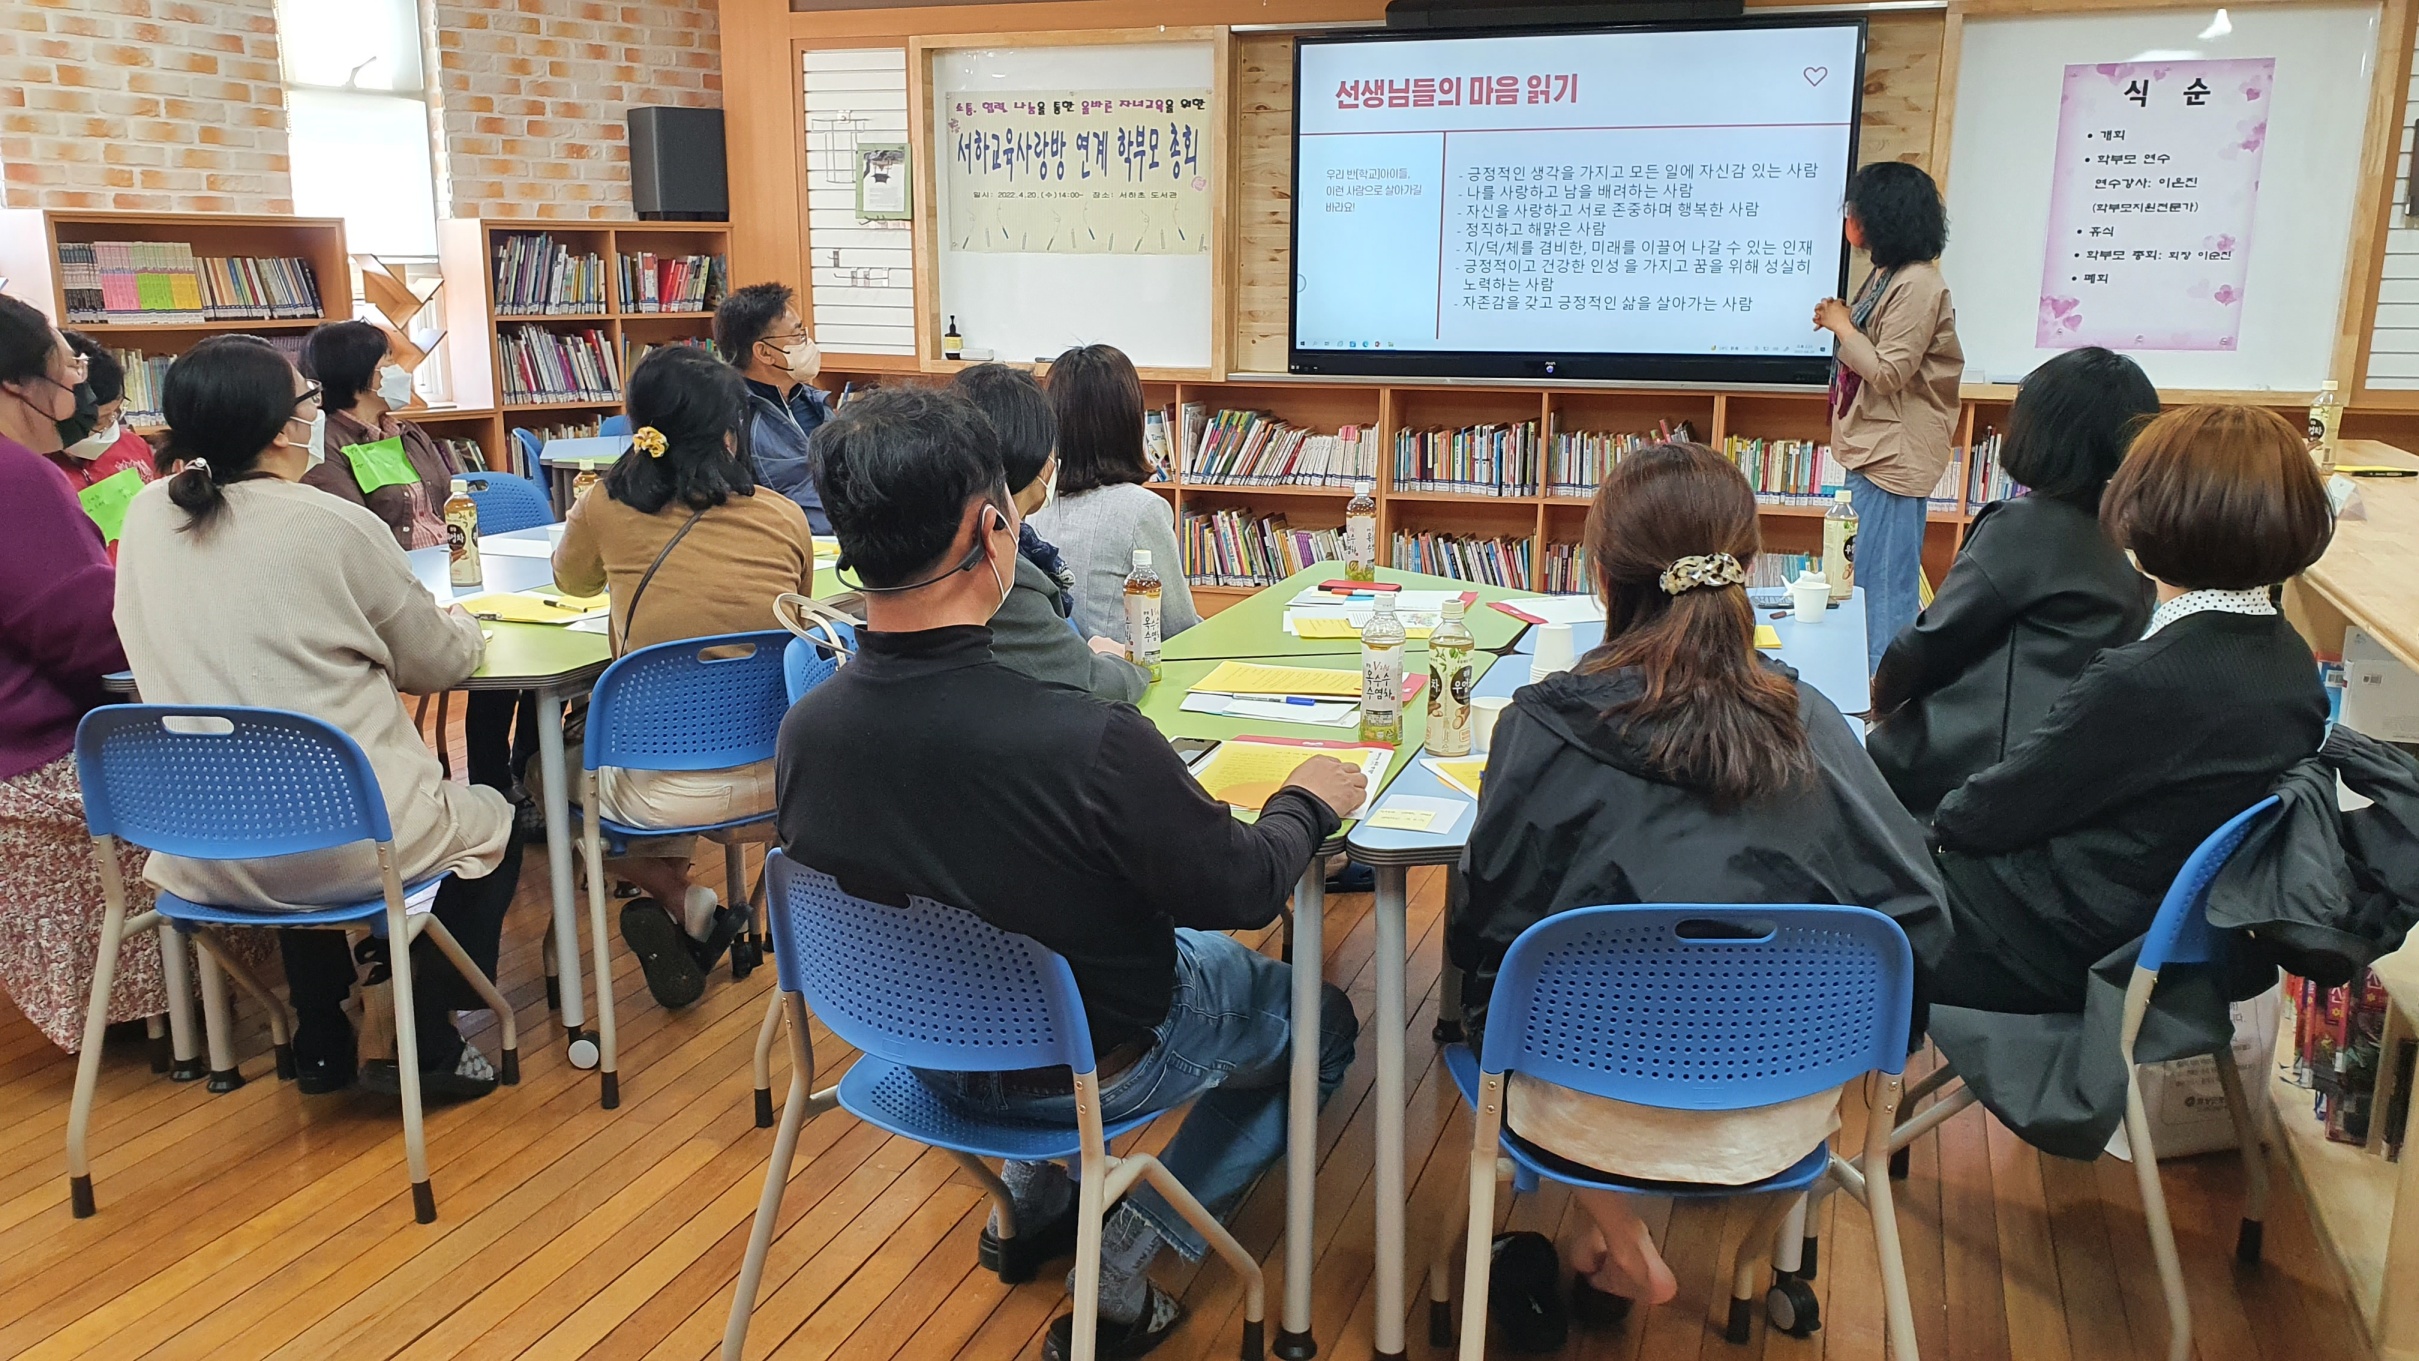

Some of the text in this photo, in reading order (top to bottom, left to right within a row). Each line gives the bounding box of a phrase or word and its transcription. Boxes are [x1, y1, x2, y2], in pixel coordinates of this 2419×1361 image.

[1335, 73, 1578, 109] 선생님들의 마음 읽기
[2123, 77, 2211, 107] 식 순
[1014, 101, 1046, 115] 나눔을
[1054, 100, 1076, 115] 통한
[1081, 100, 1113, 115] 올바른
[1119, 99, 1174, 113] 자녀교육을
[1180, 98, 1206, 110] 위한
[2100, 129, 2126, 141] 개회
[957, 122, 1199, 182] 서하교육사랑방 연계 학부모 총회
[2097, 153, 2171, 165] 학부모 연수
[1326, 169, 1345, 180] 우리
[1467, 162, 1819, 182] 긍정적인 생각을 가지고 모든 일에 자신감 있는 사람
[1326, 184, 1422, 196] 이런 사람으로 살아가길
[1466, 182, 1694, 201] 나를 사랑하고 남을 배려하는 사람
[2095, 178, 2152, 189] 연수강사:
[1151, 191, 1178, 199] 도서관
[1466, 201, 1760, 219] 자신을 사랑하고 서로 존중하며 행복한 사람
[2092, 202, 2199, 213] (학부모지원전문가)
[1465, 221, 1607, 238] 정직하고 해맑은 사람
[2088, 226, 2115, 237] 휴식
[1591, 239, 1637, 256] 미래를
[1641, 239, 1687, 256] 이끌어
[1691, 239, 1722, 256] 나갈
[1726, 240, 1741, 256] 수
[1746, 239, 1777, 256] 있는
[1782, 239, 1814, 256] 인재
[2086, 250, 2126, 261] 학부모
[2132, 250, 2163, 261] 총회:
[2168, 250, 2192, 261] 회장
[1464, 259, 1537, 275] 긍정적이고
[1541, 259, 1586, 275] 건강한
[1590, 259, 1619, 274] 인성
[1643, 258, 1689, 274] 가지고
[1693, 258, 1724, 274] 꿈을
[1728, 258, 1759, 275] 위해
[1764, 258, 1811, 275] 성실히
[1462, 277, 1555, 293] 노력하는 사람
[2083, 273, 2109, 284] 폐회
[1462, 295, 1753, 312] 자존감을 갖고 긍정적인 삶을 살아가는 사람
[1365, 669, 1391, 687] 옥수수
